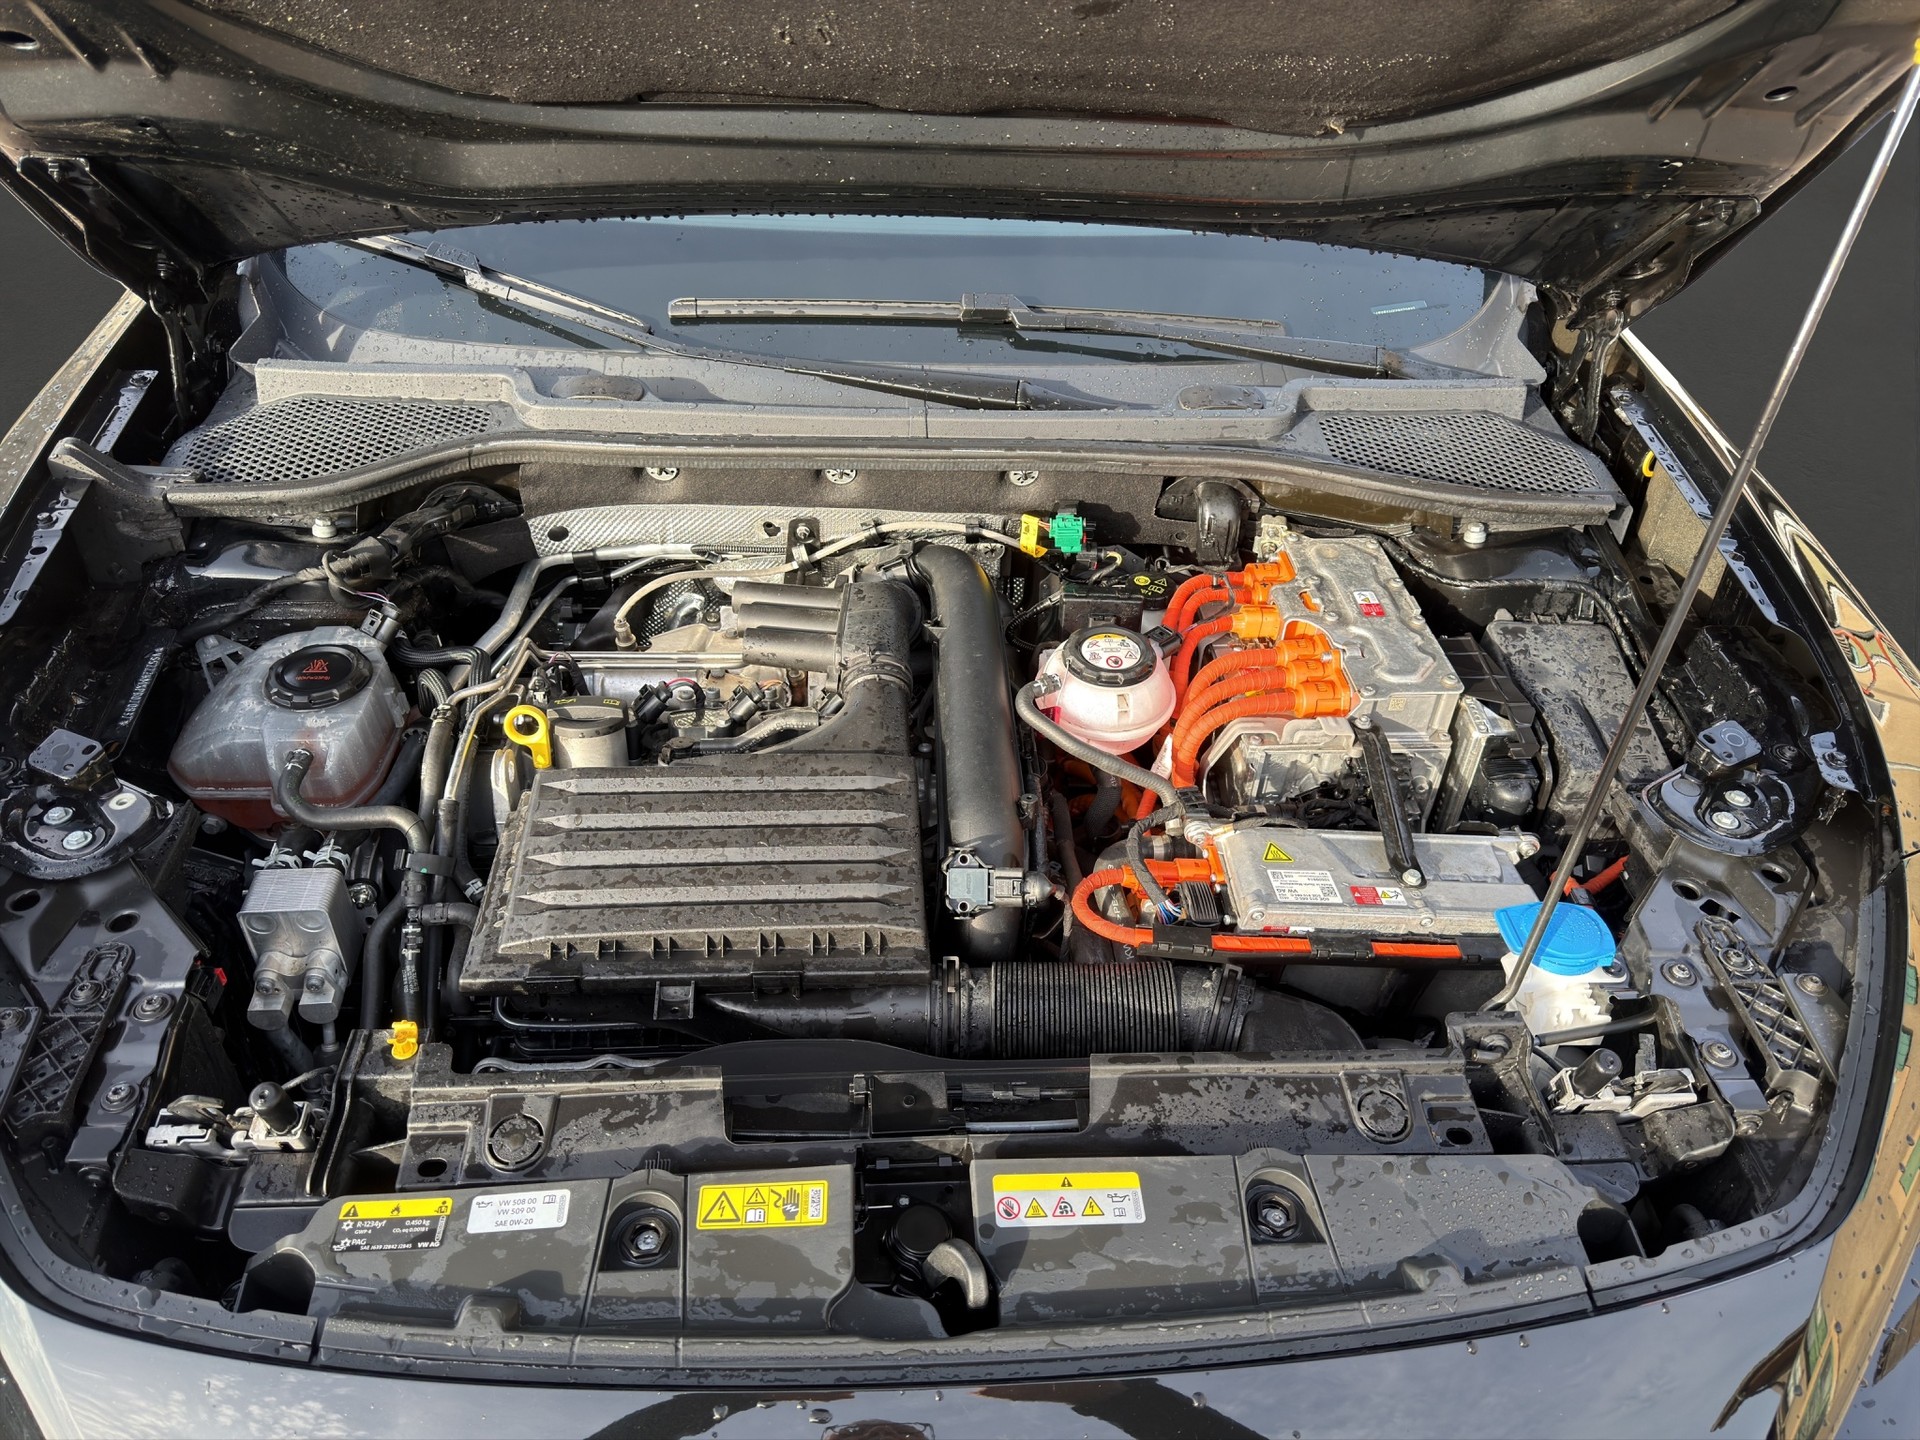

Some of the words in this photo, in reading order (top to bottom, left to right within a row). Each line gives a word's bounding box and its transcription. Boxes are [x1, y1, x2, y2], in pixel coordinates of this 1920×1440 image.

[512, 1198, 526, 1206] 508
[511, 1207, 524, 1215] 509
[356, 1219, 387, 1229] R-1234yf
[509, 1218, 534, 1226] 0W-20
